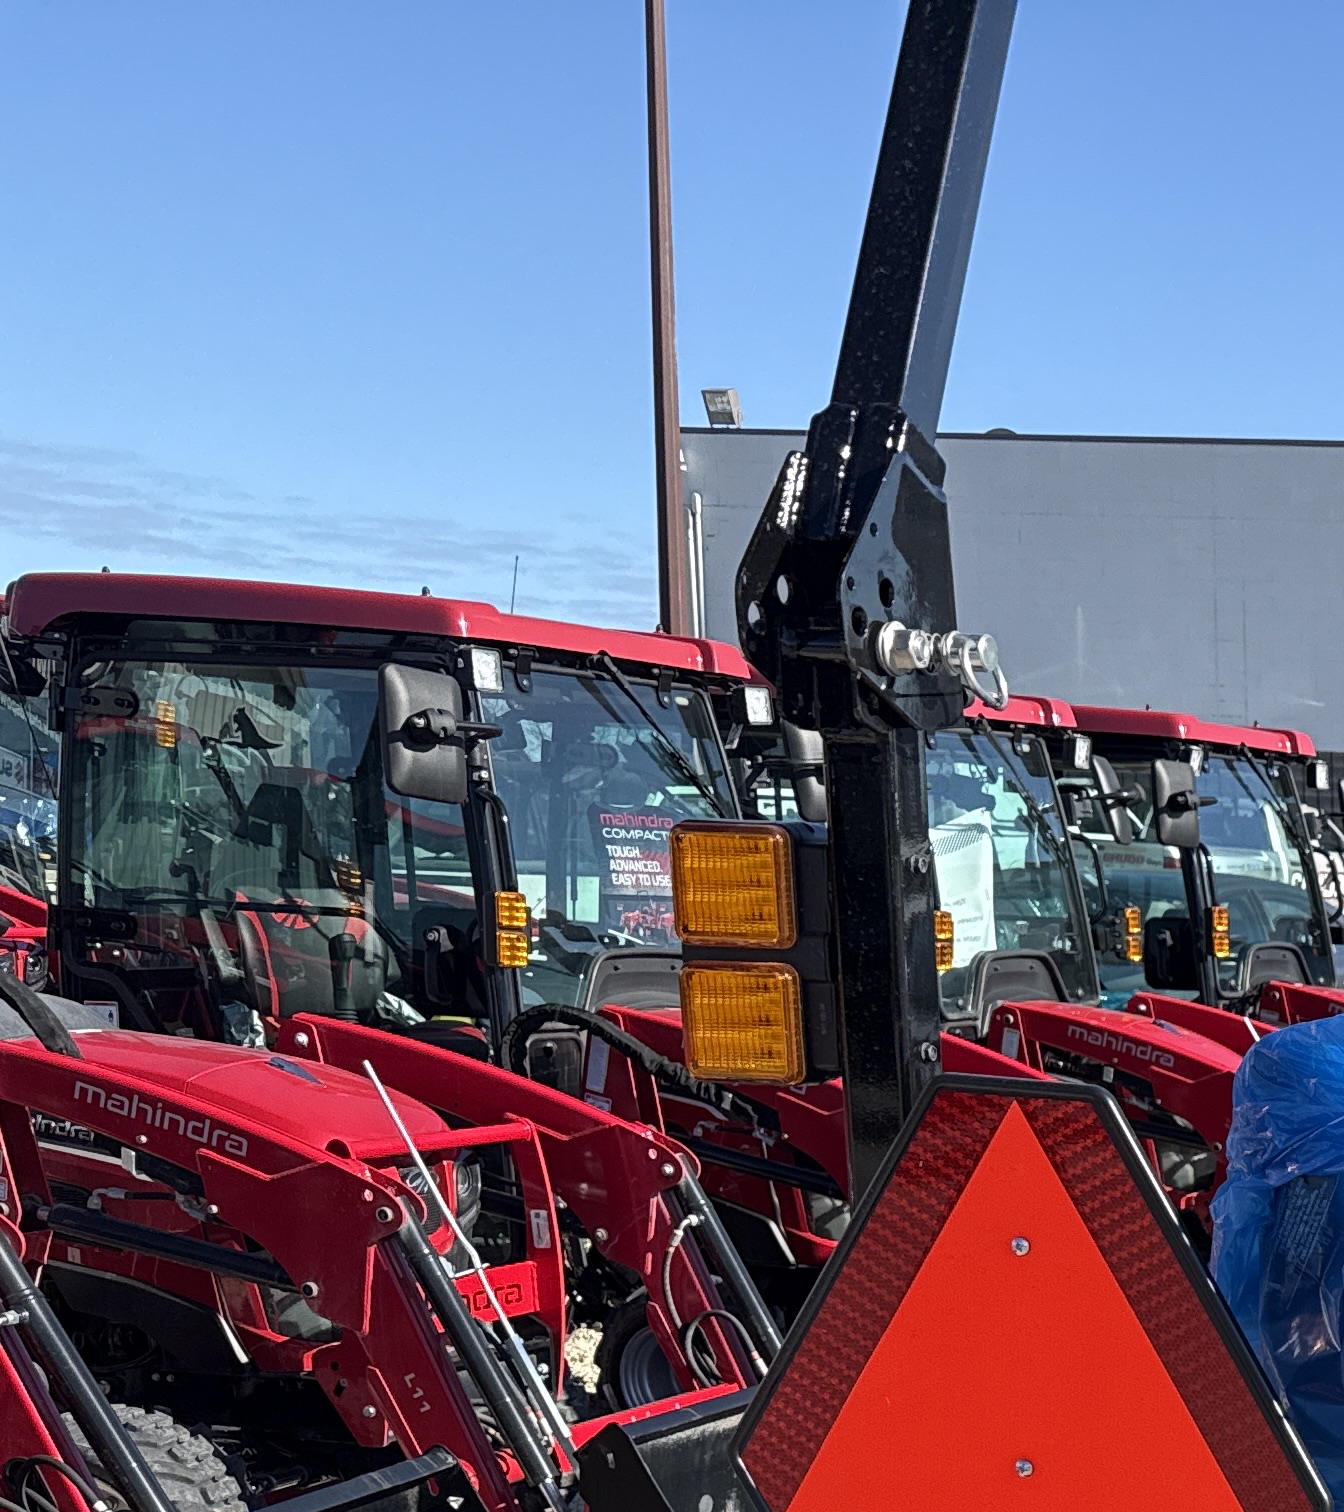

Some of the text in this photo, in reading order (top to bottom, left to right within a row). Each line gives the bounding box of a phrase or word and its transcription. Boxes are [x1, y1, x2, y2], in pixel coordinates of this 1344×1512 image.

[600, 812, 673, 828] mahindra
[602, 827, 670, 841] COMPACT
[605, 844, 642, 858] TOUGH.
[609, 858, 663, 873] ADVANCED.
[612, 872, 636, 887] EASY
[637, 873, 651, 887] TO
[1067, 1024, 1175, 1068] mahindra
[73, 1080, 249, 1158] mahindra
[404, 1373, 431, 1413] L11
